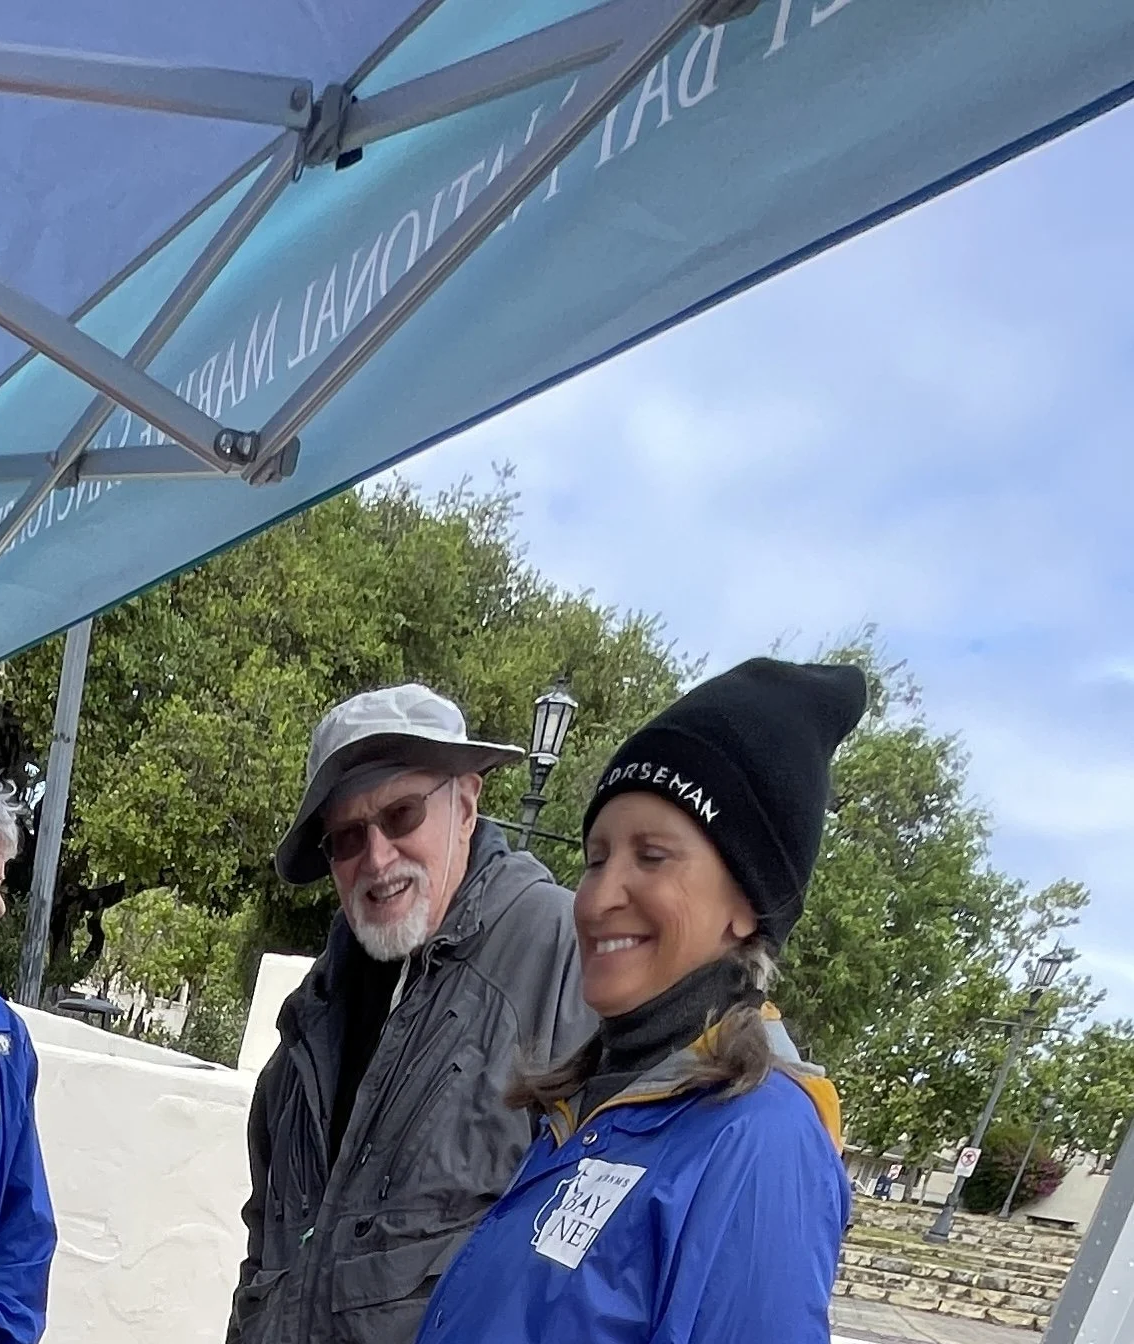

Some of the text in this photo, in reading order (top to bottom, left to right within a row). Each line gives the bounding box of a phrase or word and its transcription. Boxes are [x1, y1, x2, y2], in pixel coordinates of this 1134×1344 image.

[597, 761, 720, 823] ORSEMAN
[562, 1191, 611, 1219] BAY
[548, 1215, 600, 1251] NET
